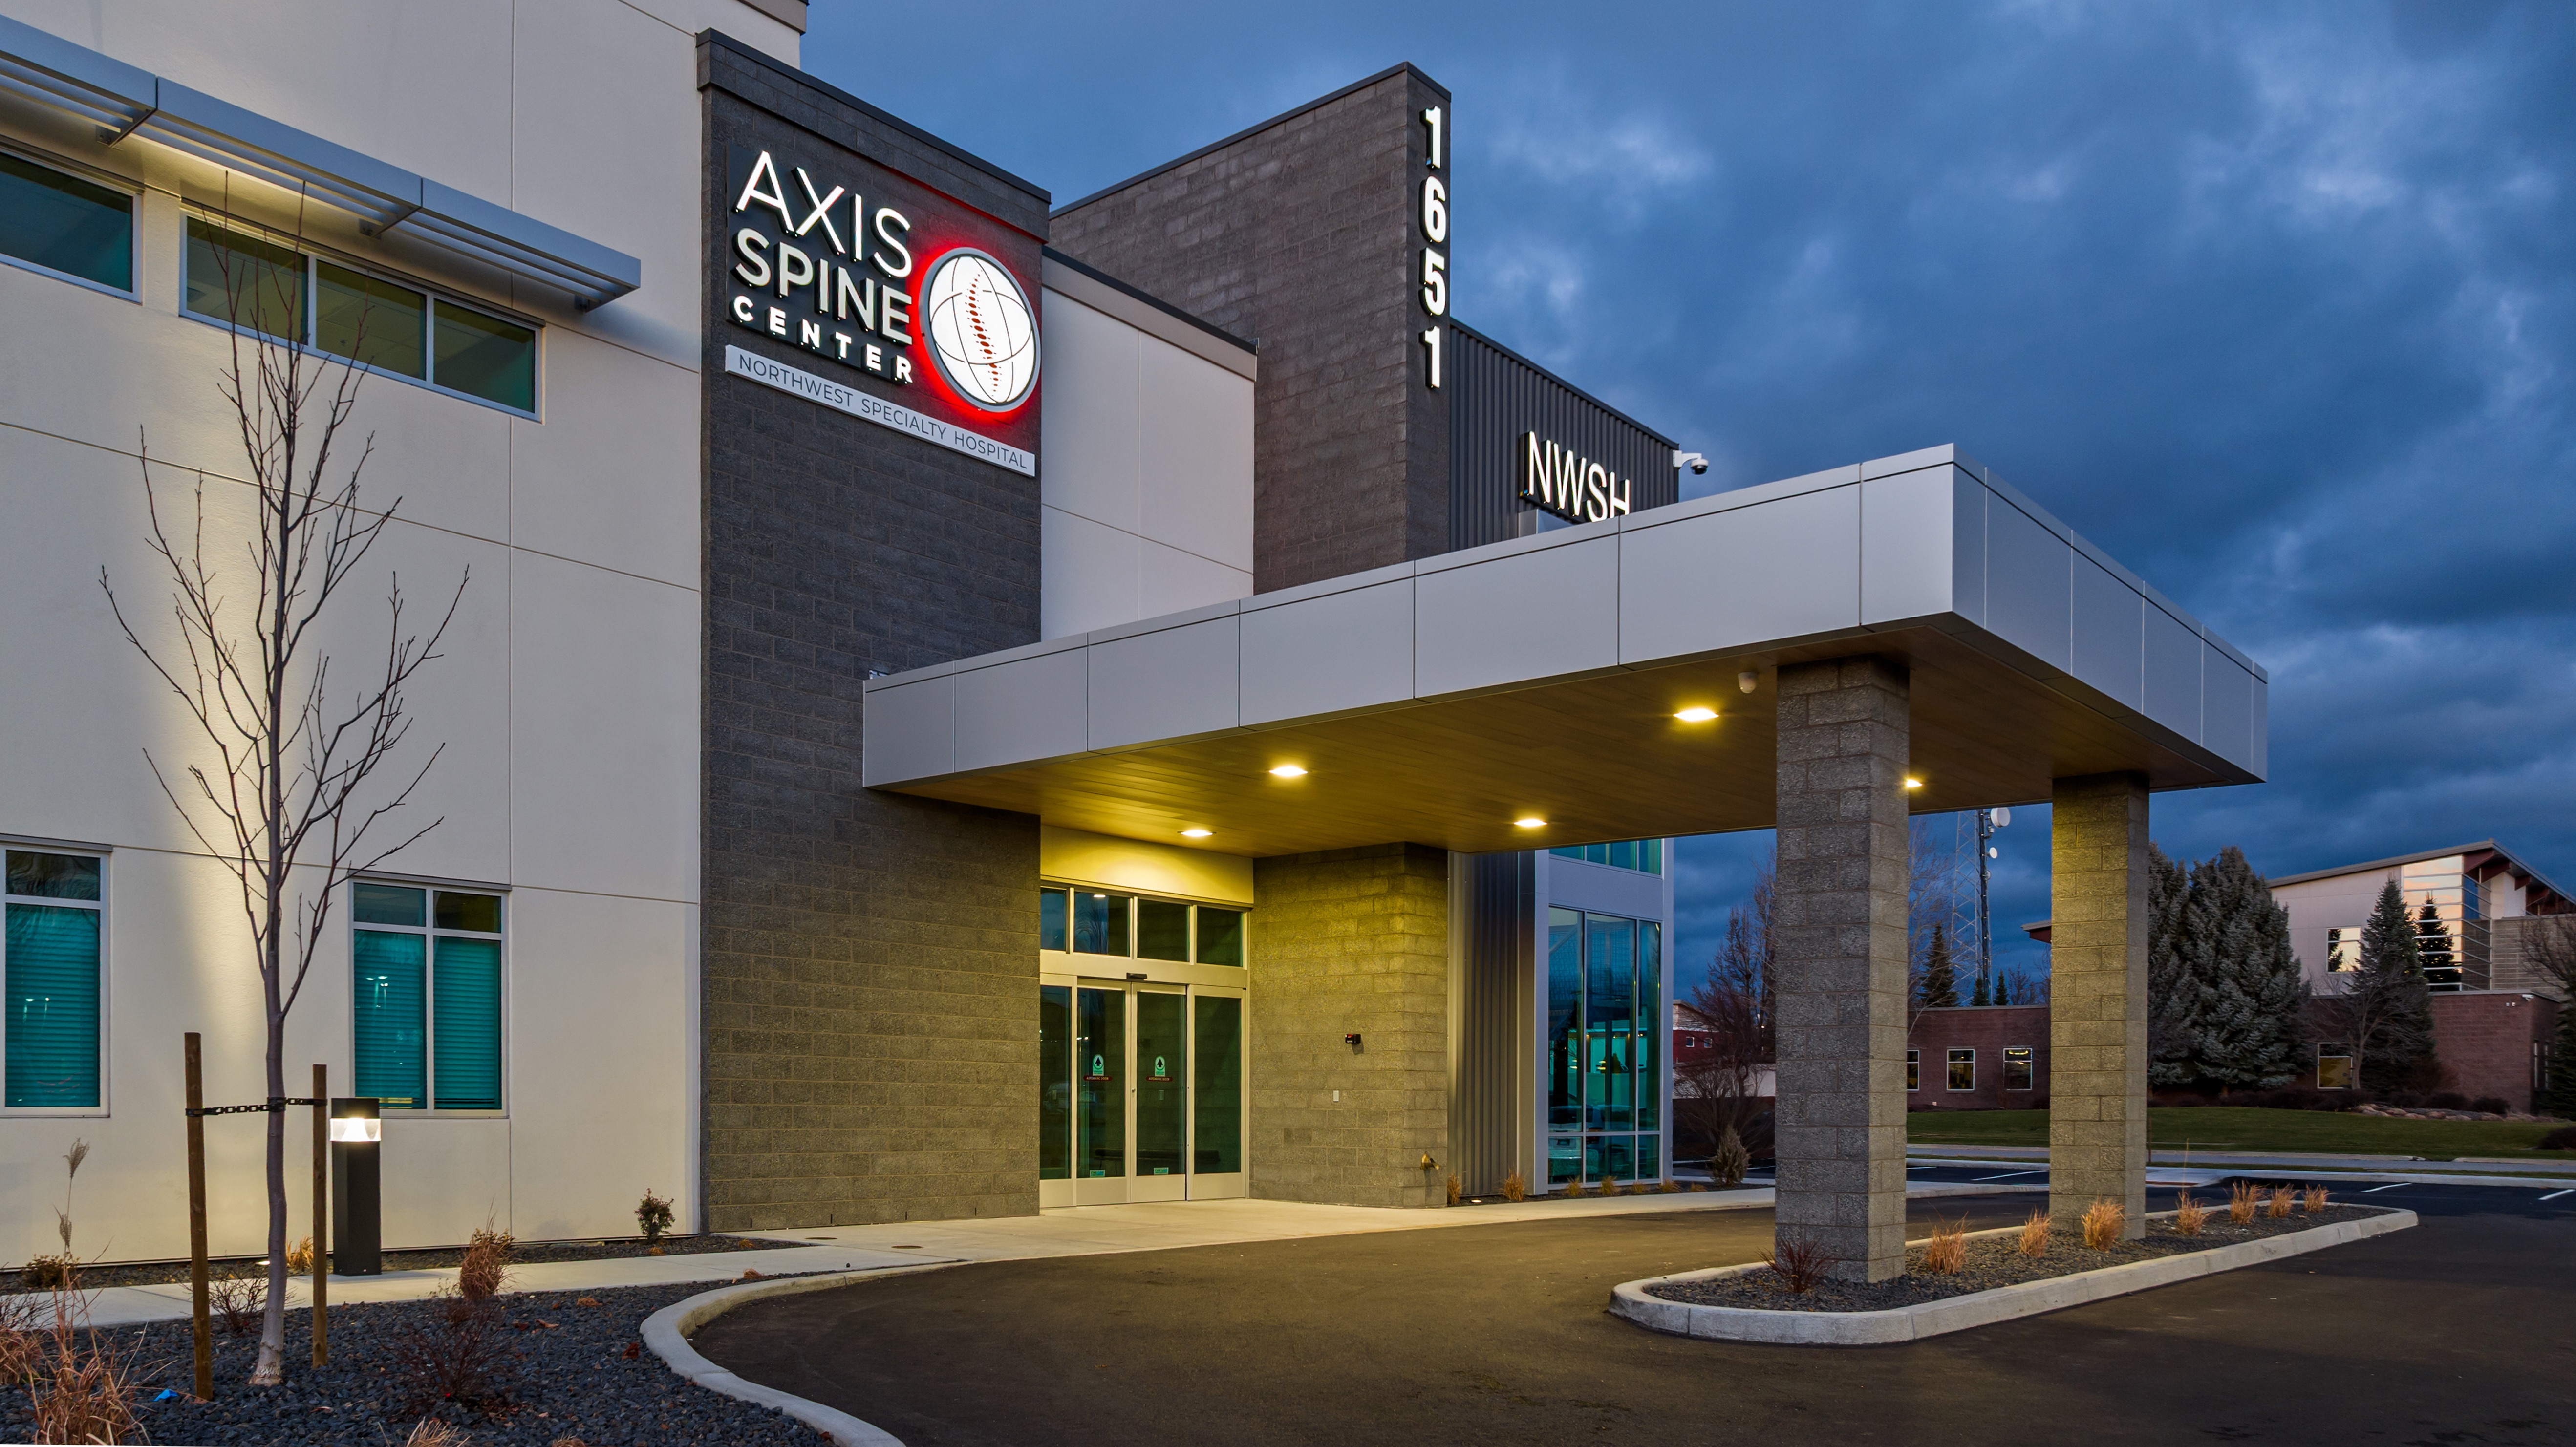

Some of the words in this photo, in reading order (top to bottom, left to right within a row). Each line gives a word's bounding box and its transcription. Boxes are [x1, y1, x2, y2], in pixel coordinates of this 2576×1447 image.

[735, 150, 912, 278] AXIS
[1423, 106, 1446, 388] 1651
[733, 295, 913, 383] CENTER
[735, 228, 912, 345] SPINE
[739, 354, 853, 407] NORTHWEST
[861, 398, 946, 440] SPECIALTY
[954, 431, 1027, 469] HOSPITAL
[1528, 430, 1631, 523] NWSH
